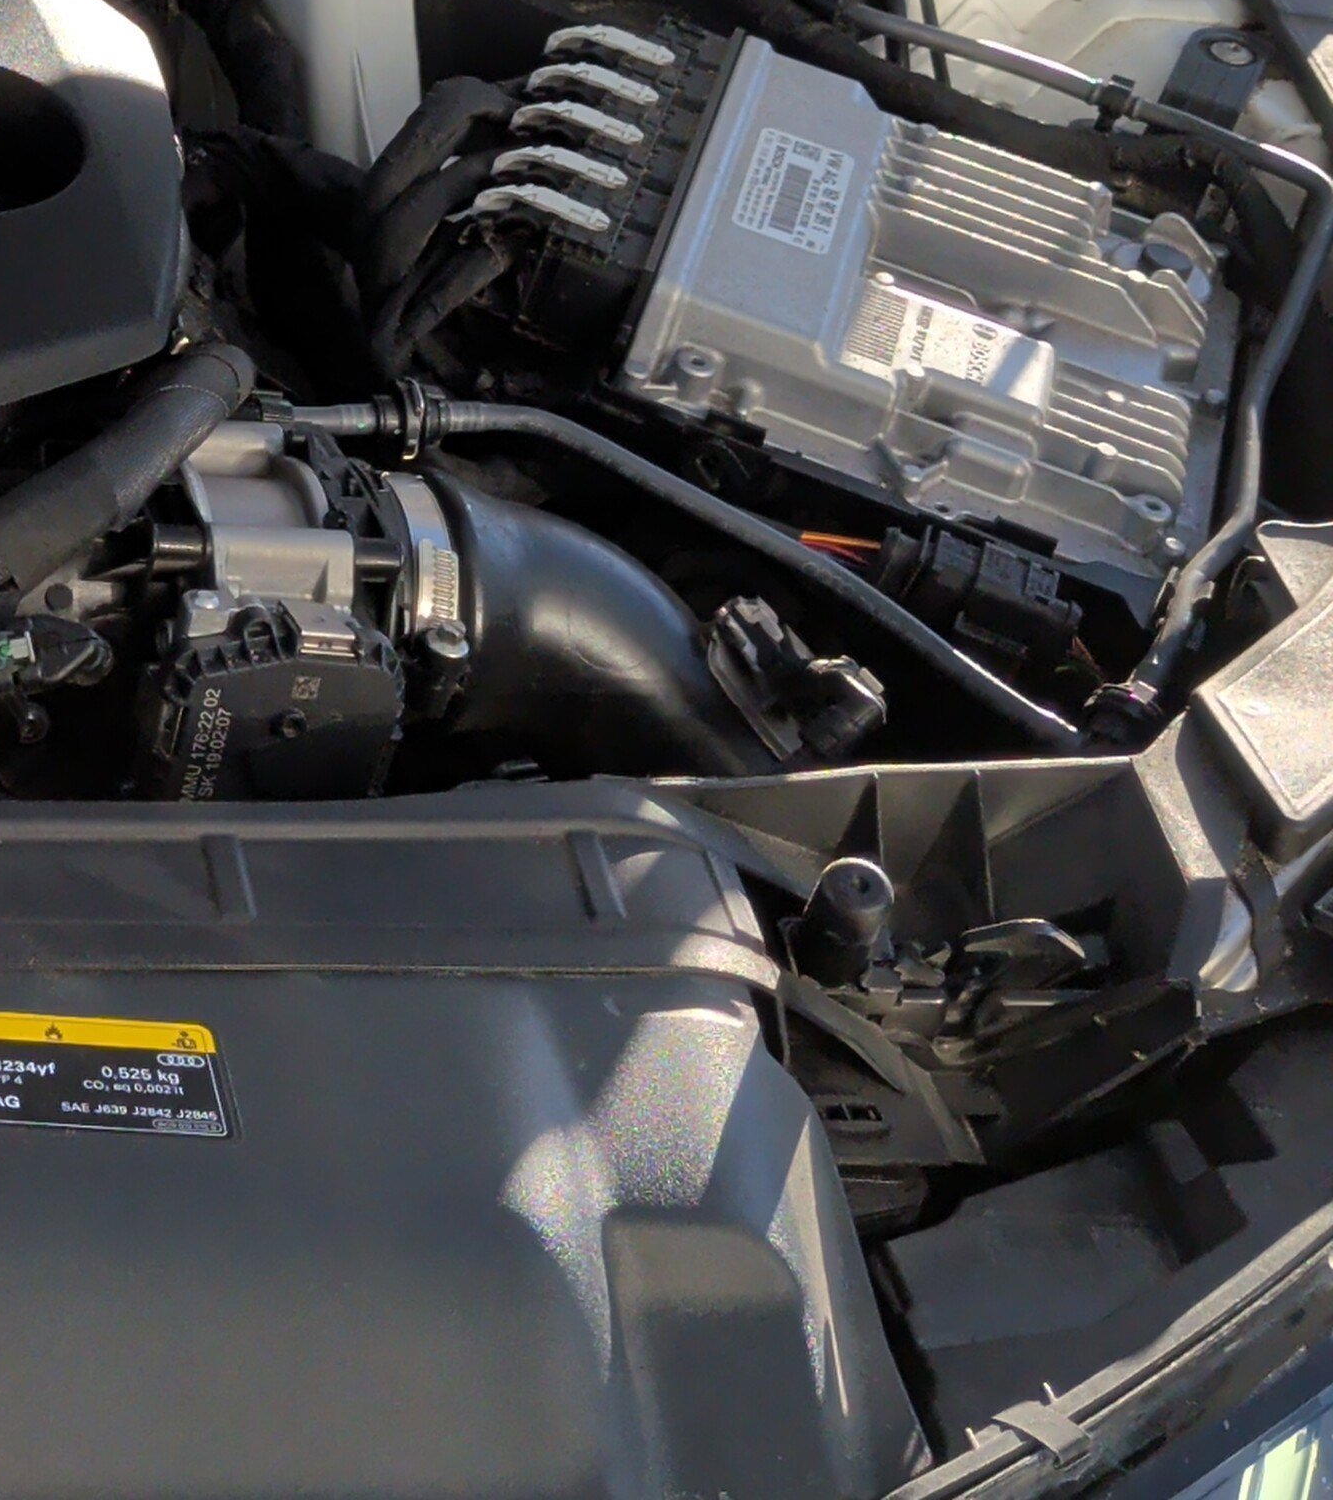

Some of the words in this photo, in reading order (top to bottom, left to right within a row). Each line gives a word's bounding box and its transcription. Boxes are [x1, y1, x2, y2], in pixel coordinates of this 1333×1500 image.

[203, 688, 221, 708] 02
[15, 1074, 23, 1085] 4
[101, 1065, 152, 1082] 0,525
[157, 1068, 180, 1085] kg
[61, 1101, 90, 1113] SAE
[94, 1104, 128, 1115] J639
[132, 1106, 172, 1119] J2842
